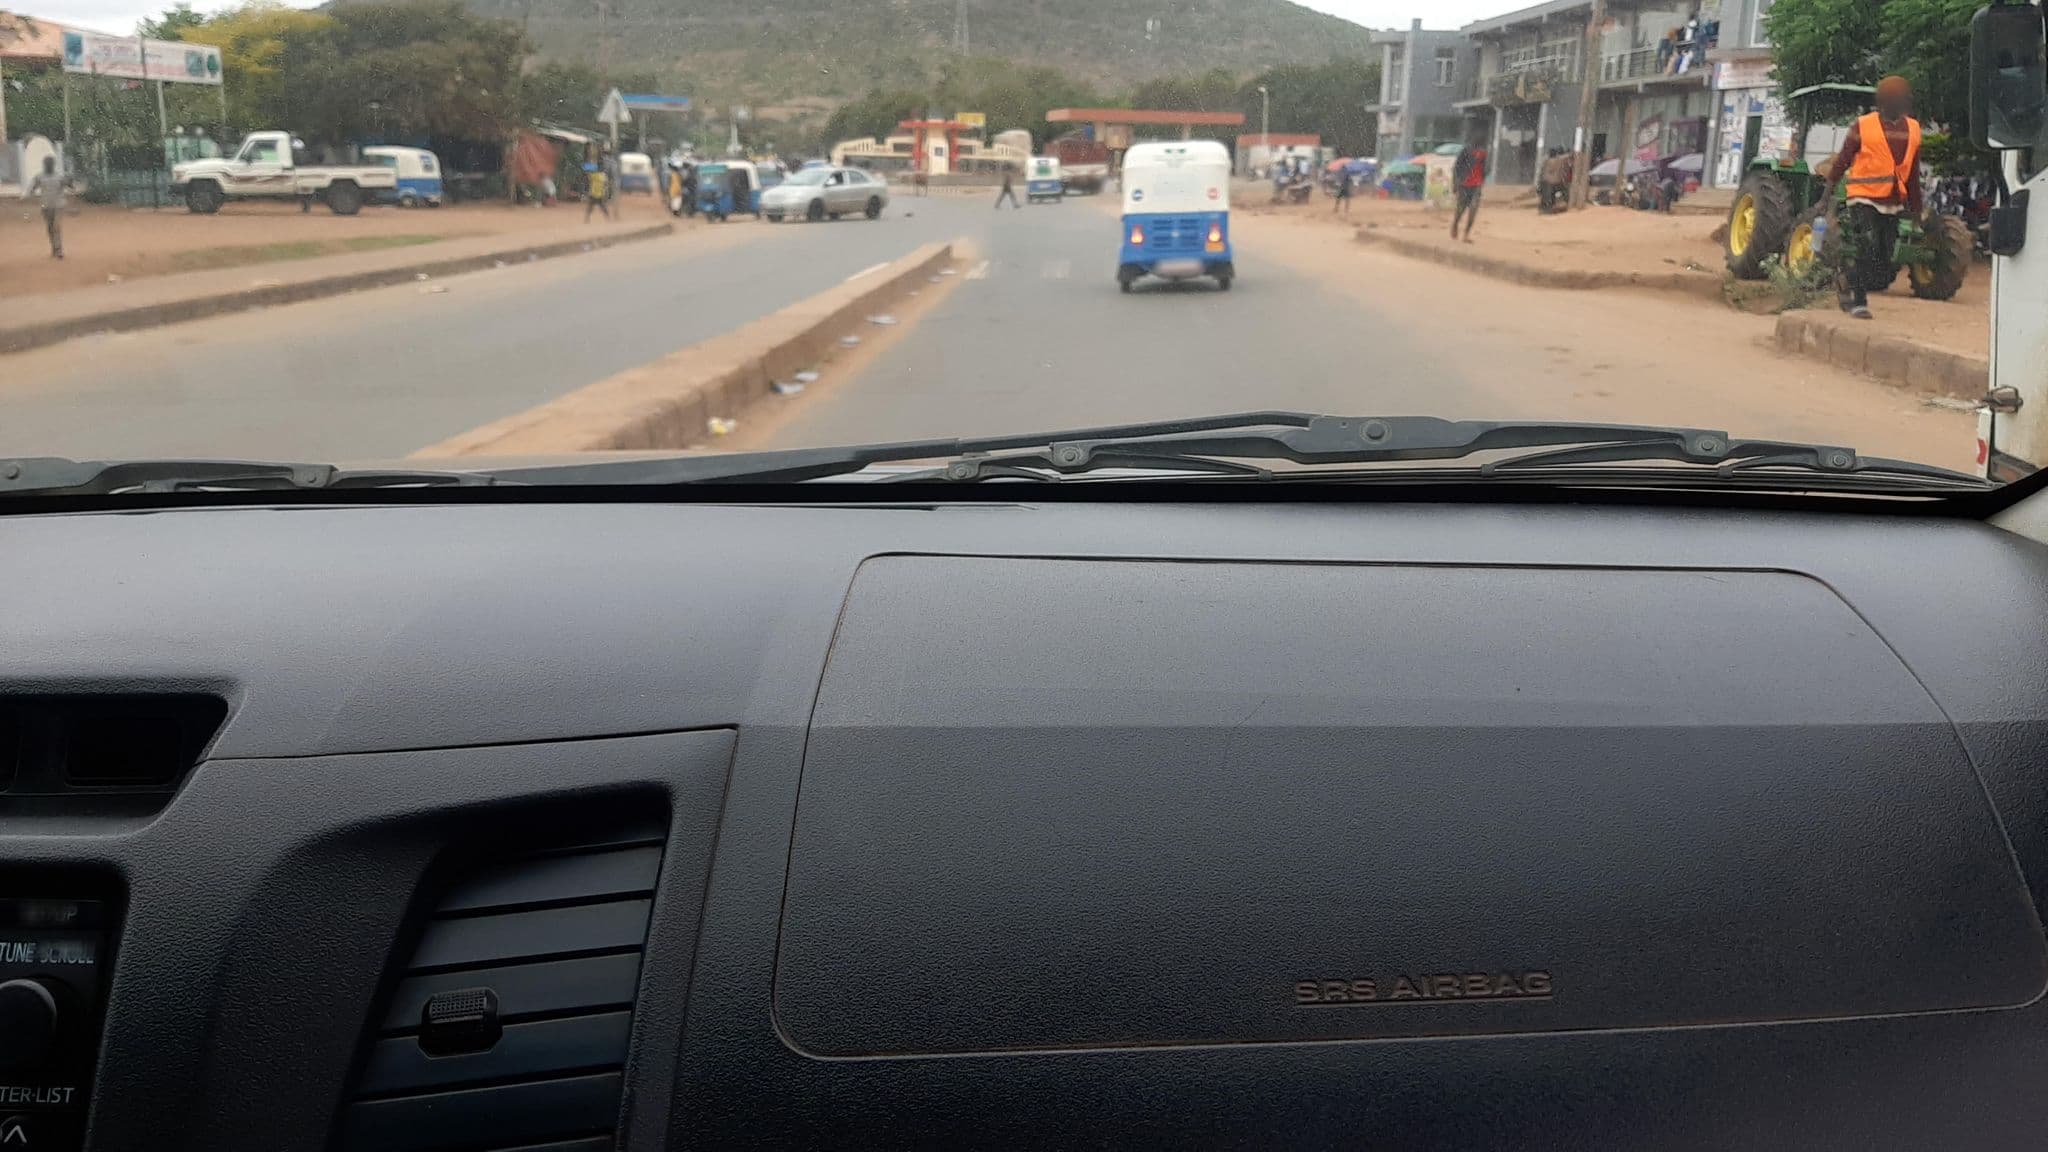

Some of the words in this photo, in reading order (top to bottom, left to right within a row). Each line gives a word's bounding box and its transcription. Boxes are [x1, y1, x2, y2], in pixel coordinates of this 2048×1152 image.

[0, 942, 37, 963] TUNE
[1295, 978, 1377, 1001] SRS
[1390, 971, 1551, 998] AIRBAG
